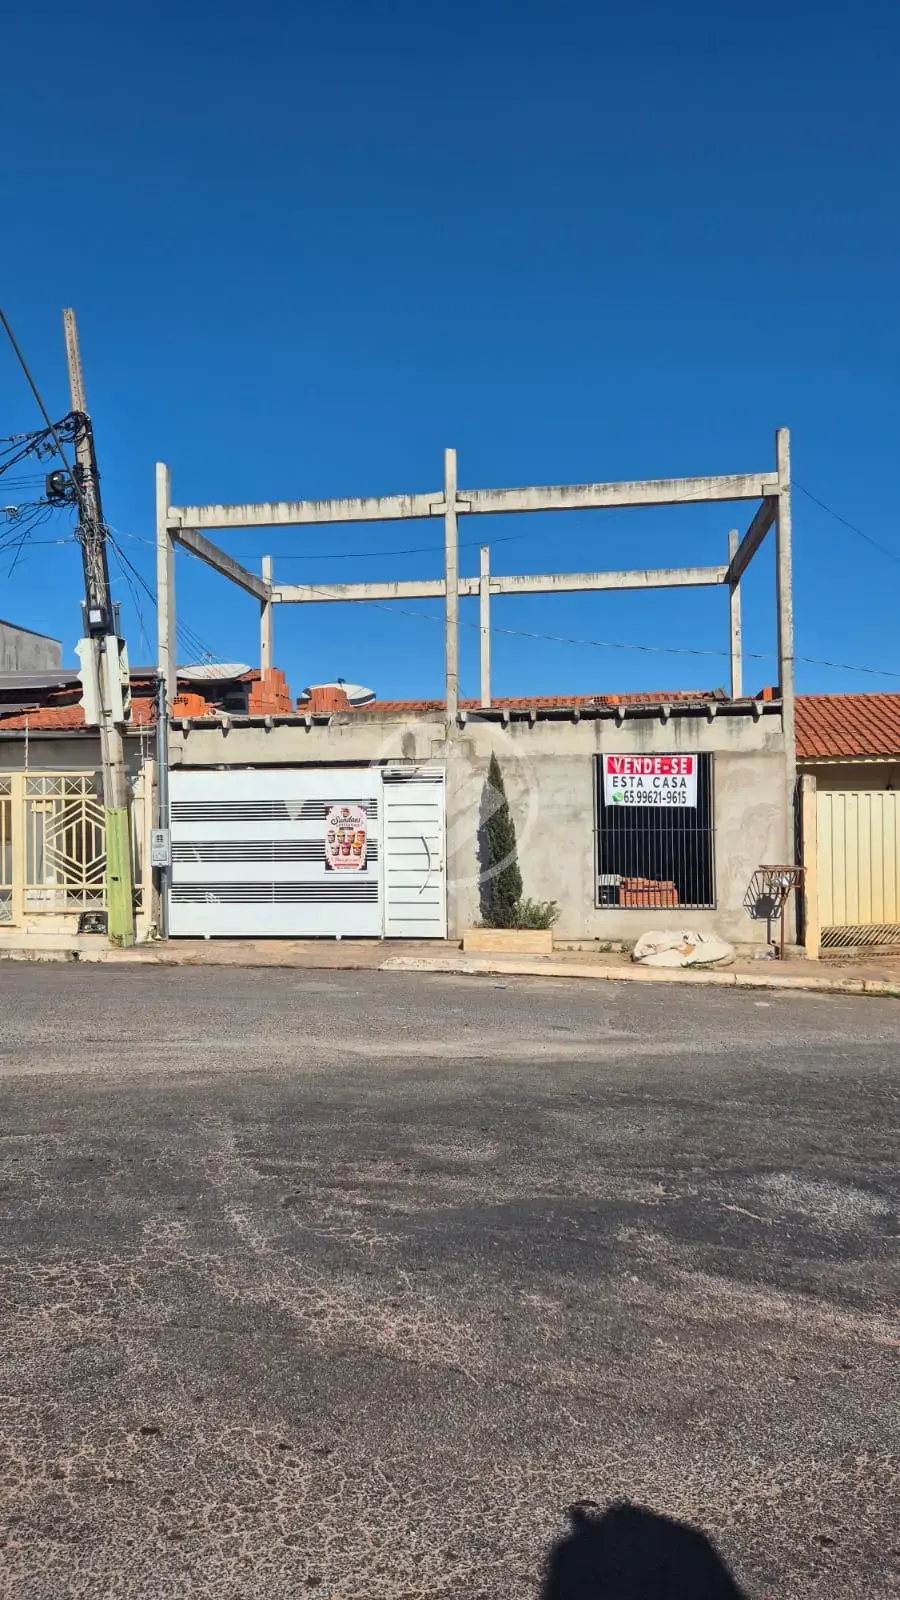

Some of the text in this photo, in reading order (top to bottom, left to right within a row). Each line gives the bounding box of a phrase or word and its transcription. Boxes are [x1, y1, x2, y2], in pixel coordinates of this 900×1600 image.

[613, 757, 688, 774] VENDE-SE
[612, 776, 687, 788] ESTA CASA
[623, 790, 687, 804] 65.99621-9615
